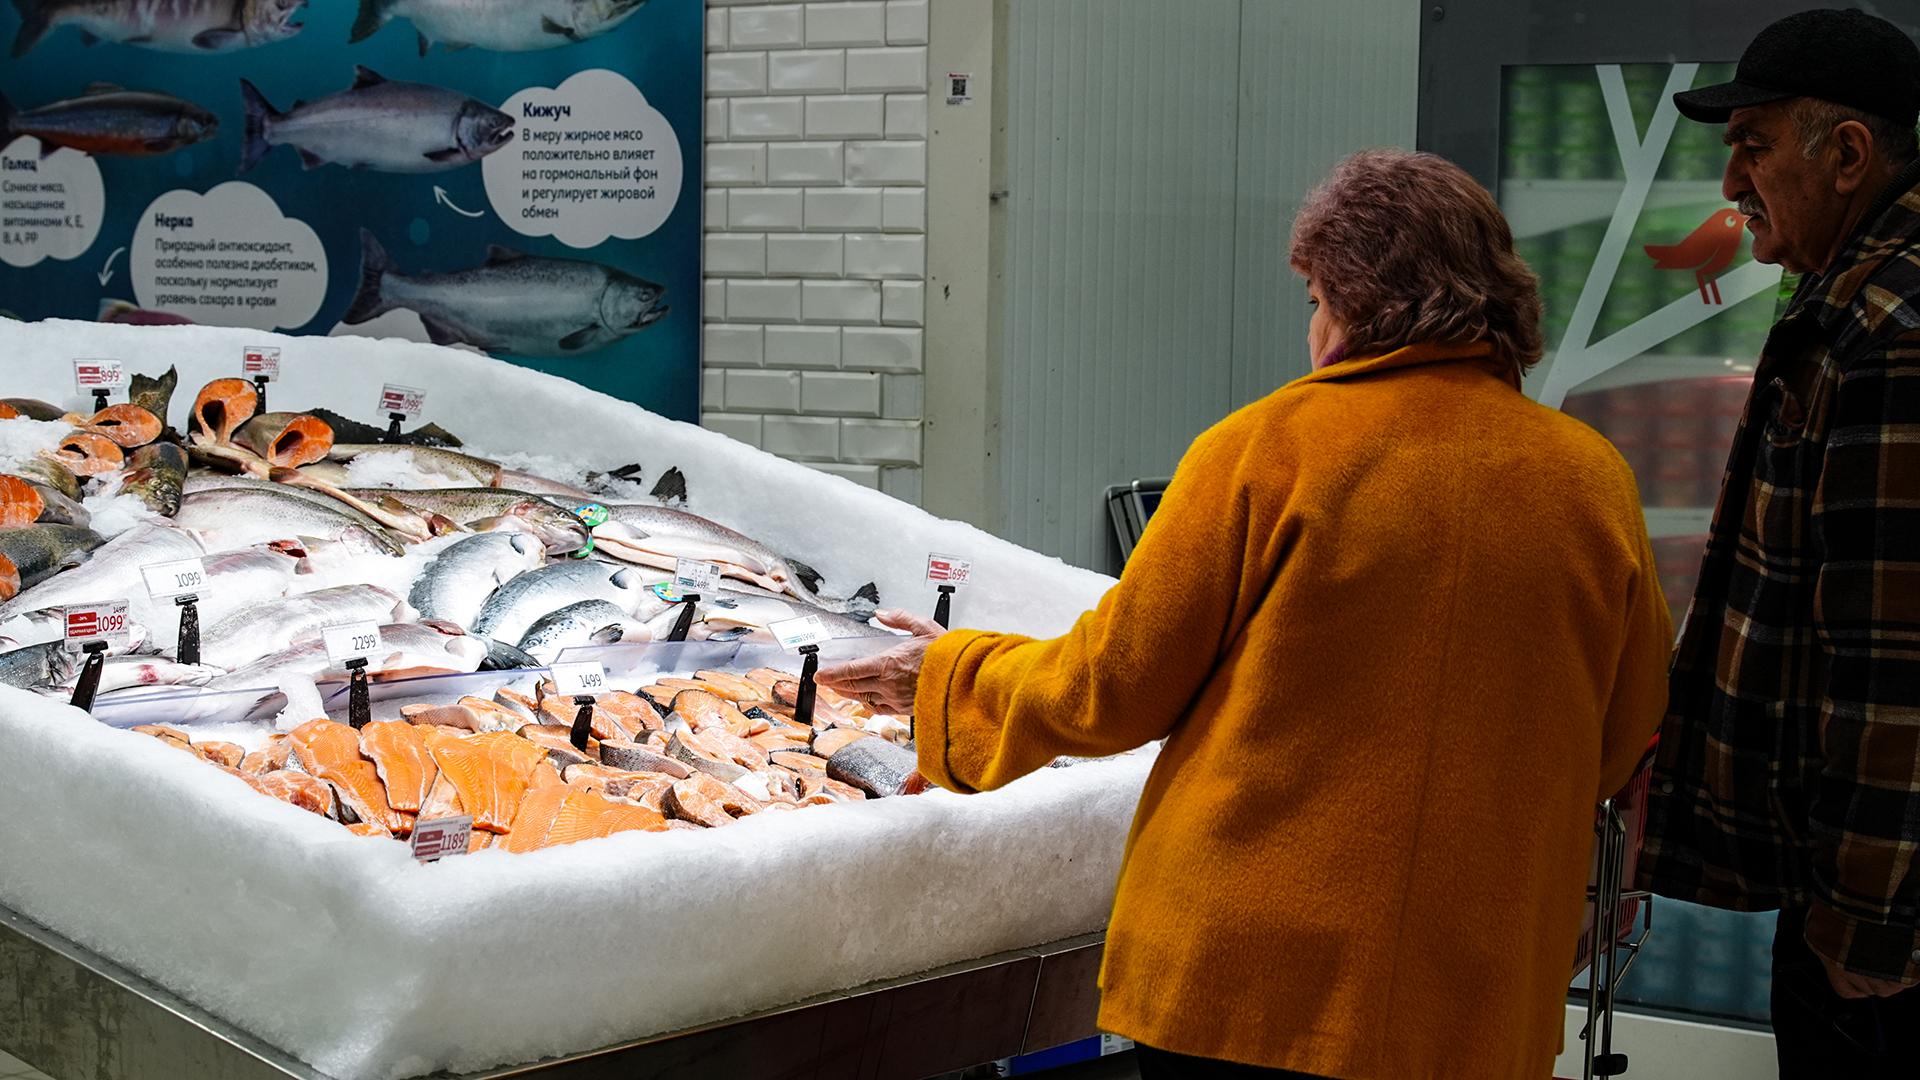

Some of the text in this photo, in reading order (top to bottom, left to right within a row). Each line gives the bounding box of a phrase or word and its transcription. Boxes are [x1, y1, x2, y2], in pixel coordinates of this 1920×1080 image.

[523, 102, 571, 121] Кижуч
[522, 129, 643, 144] В меру жирное мясо
[522, 149, 655, 160] положительно влияет
[522, 166, 658, 182] на гормональный фон
[522, 186, 655, 202] и регулирует жировой
[522, 205, 559, 218] обмен
[155, 213, 194, 230] Нерка
[155, 238, 293, 254] Природный антиоксидант,
[155, 257, 317, 272] особенно полезна диабетикам,
[155, 275, 278, 291] поскольку нормализует
[155, 294, 276, 308] уровень сахара в крови
[101, 370, 119, 382] 899
[175, 572, 201, 587] 1099
[97, 615, 123, 632] 1099
[352, 634, 376, 650] 2299
[579, 673, 602, 688] 1499
[440, 832, 465, 850] 1189
